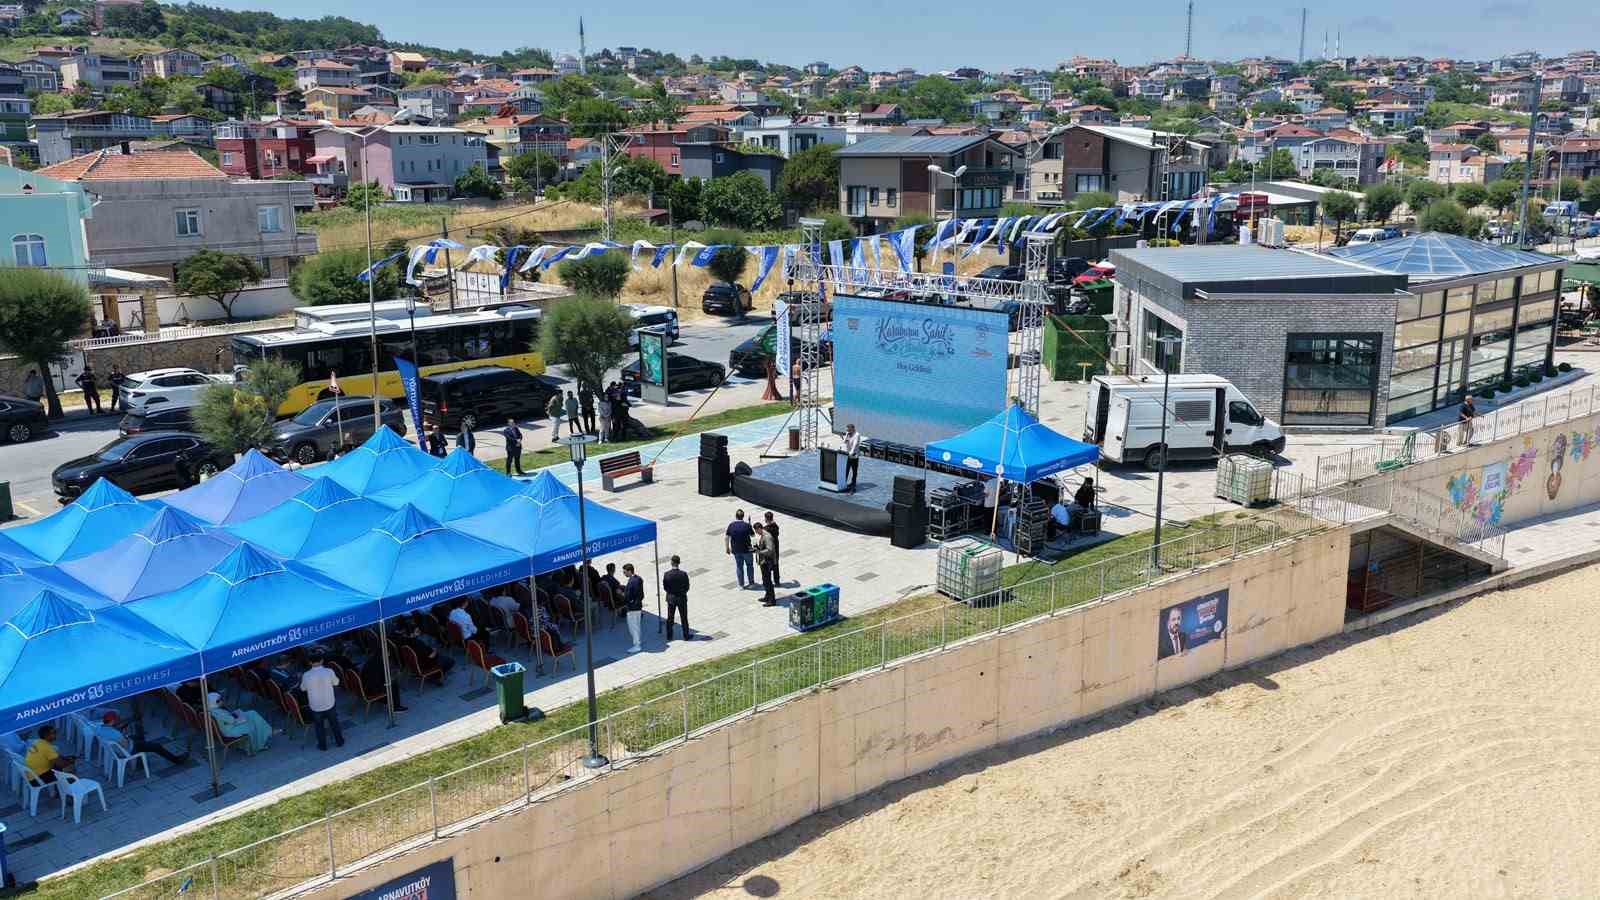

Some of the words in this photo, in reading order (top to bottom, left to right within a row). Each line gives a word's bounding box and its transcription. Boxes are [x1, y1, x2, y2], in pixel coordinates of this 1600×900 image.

[921, 318, 947, 345] Sahil
[405, 584, 454, 605] ARNAVUTKÖY
[231, 633, 288, 658] ARNAVUTKÖY
[302, 614, 356, 637] BELEDİYESİ
[15, 690, 86, 721] ARNAVUTKÖY
[105, 668, 171, 694] BELEDİYESİ
